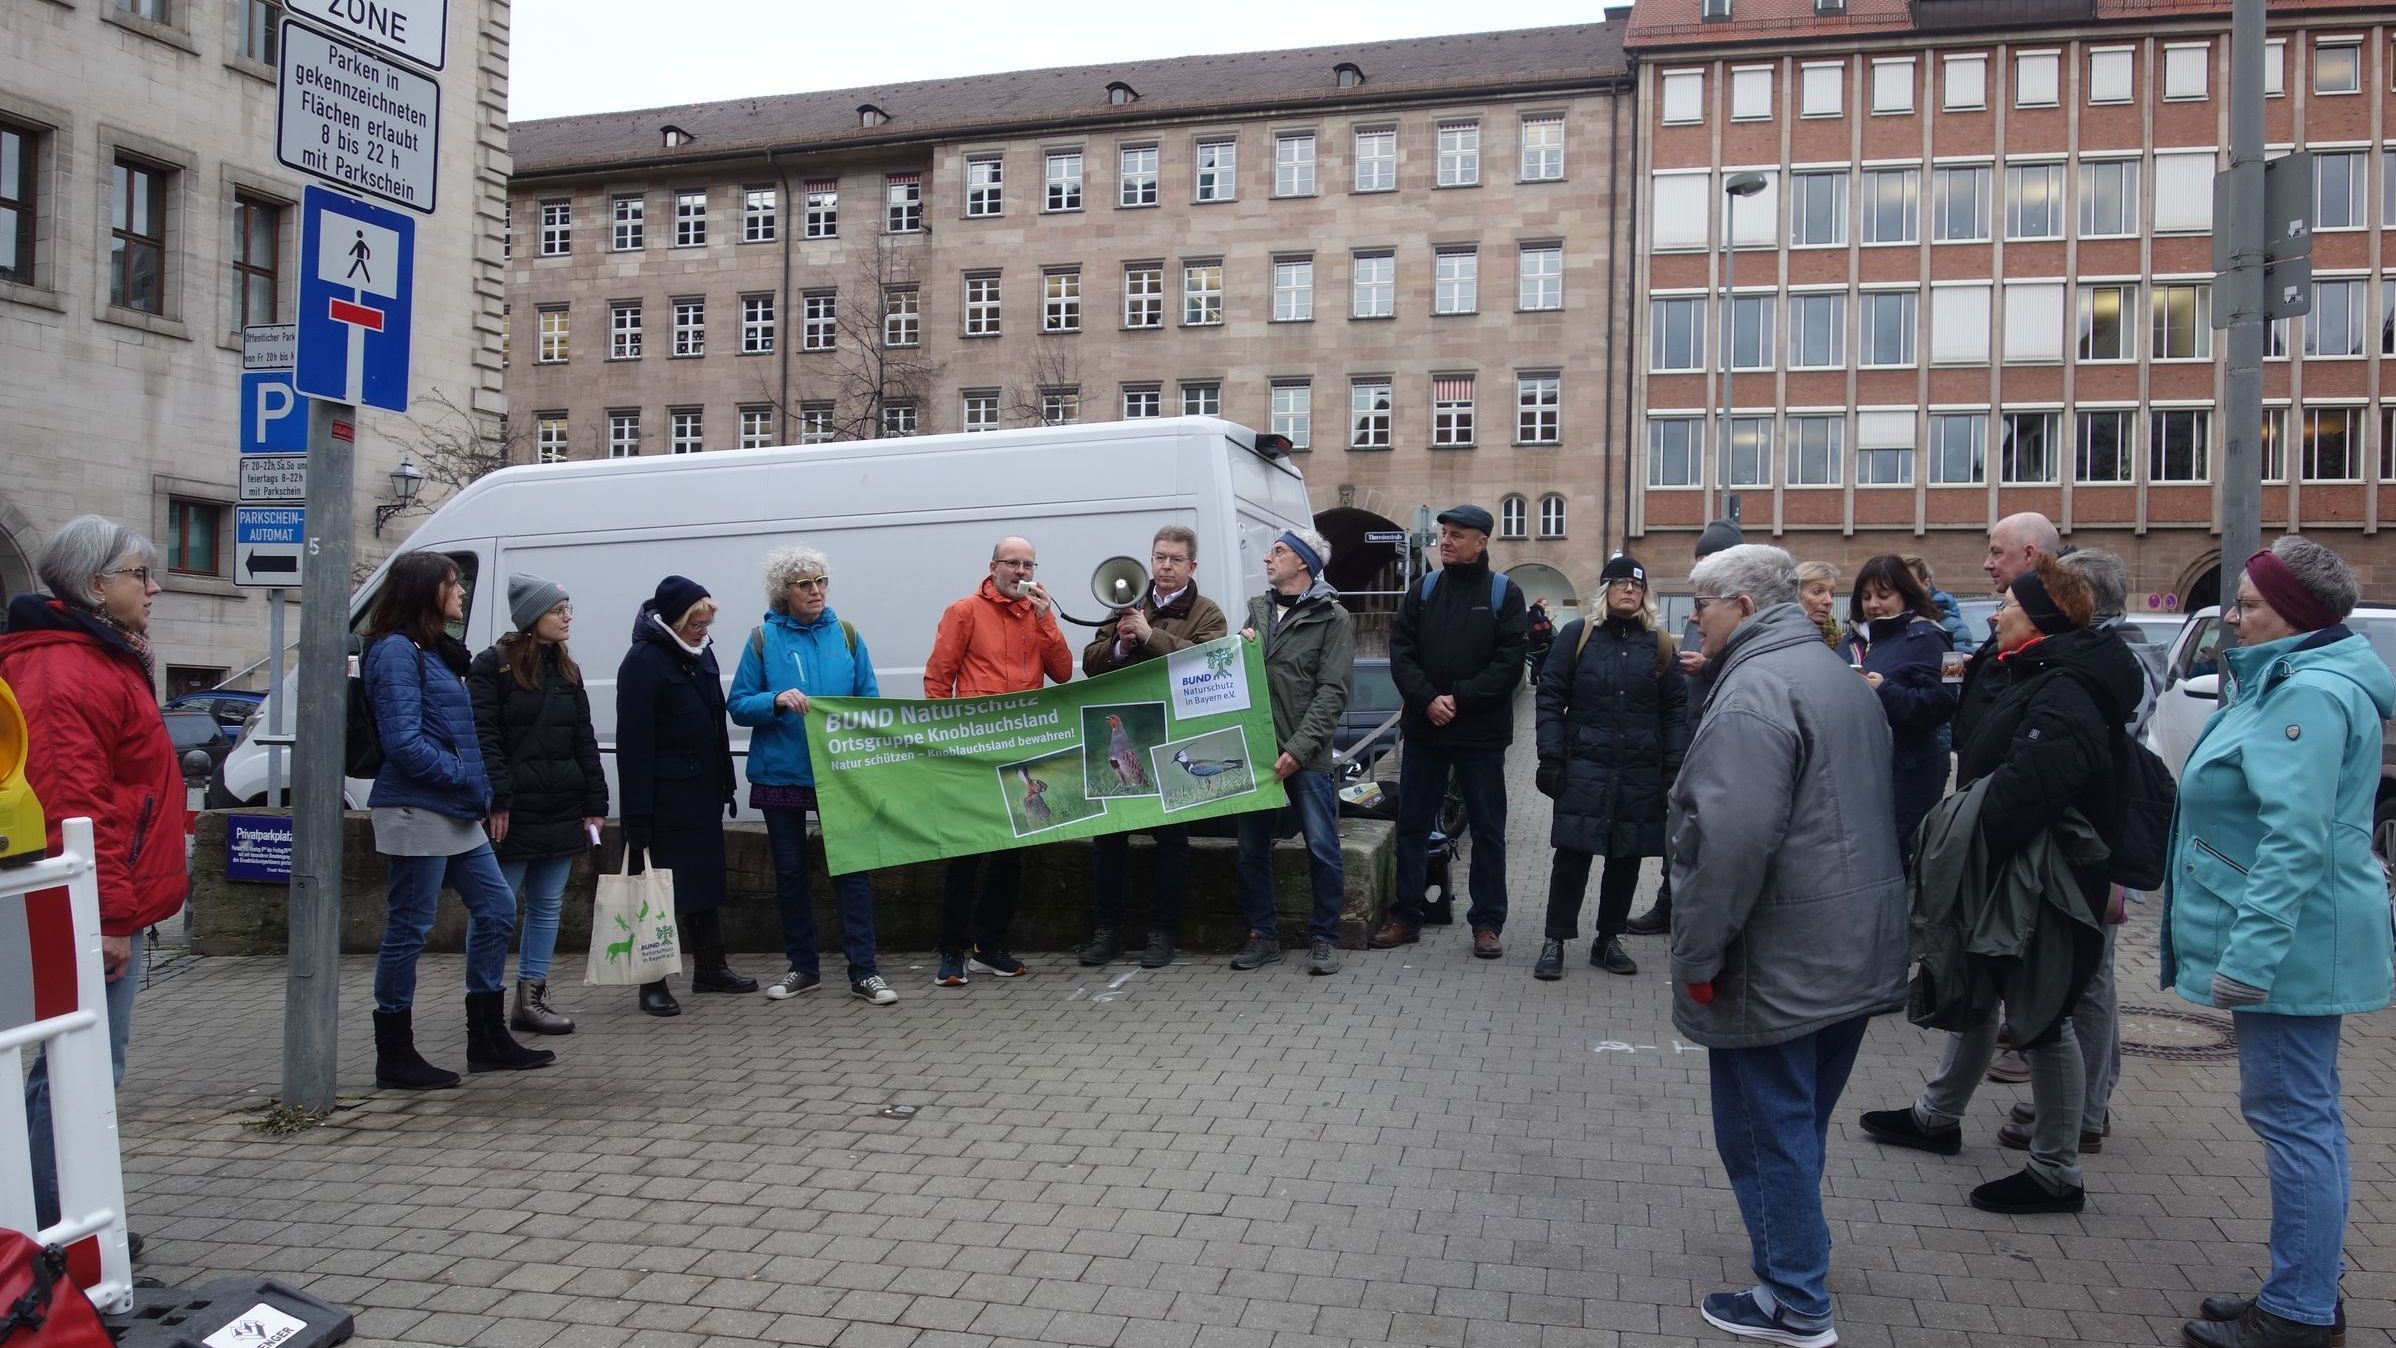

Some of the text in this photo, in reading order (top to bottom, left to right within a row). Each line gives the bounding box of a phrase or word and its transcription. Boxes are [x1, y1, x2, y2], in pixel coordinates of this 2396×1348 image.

[328, 44, 399, 91] Parken in
[296, 64, 427, 127] gekennzeichneten
[302, 90, 418, 152] Flächen erlaubt
[321, 124, 399, 170] 8 bis 22 h
[303, 149, 414, 200] mit Parkschein
[257, 353, 264, 362] Fr
[280, 352, 288, 361] bis
[256, 383, 295, 443] P
[242, 462, 249, 471] Fr
[247, 474, 278, 485] feiertags
[249, 486, 302, 496] mit Parkschein
[240, 511, 304, 525] PARKSCHEIN-
[249, 528, 294, 541] AUTOMAT
[310, 537, 320, 556] 5
[1182, 673, 1211, 686] BUND
[1183, 681, 1234, 696] Naturschutz
[1185, 698, 1193, 706] in
[1195, 694, 1222, 706] Bayern
[825, 696, 1039, 732] BUND Naturschutz
[828, 709, 1059, 755] Ortsgruppe Knoblauchsland
[831, 758, 862, 771] Natur
[865, 750, 915, 767] schützen
[928, 739, 1015, 758] Knoblauchsland
[1018, 727, 1076, 747] bewahren!
[641, 942, 660, 951] BUND
